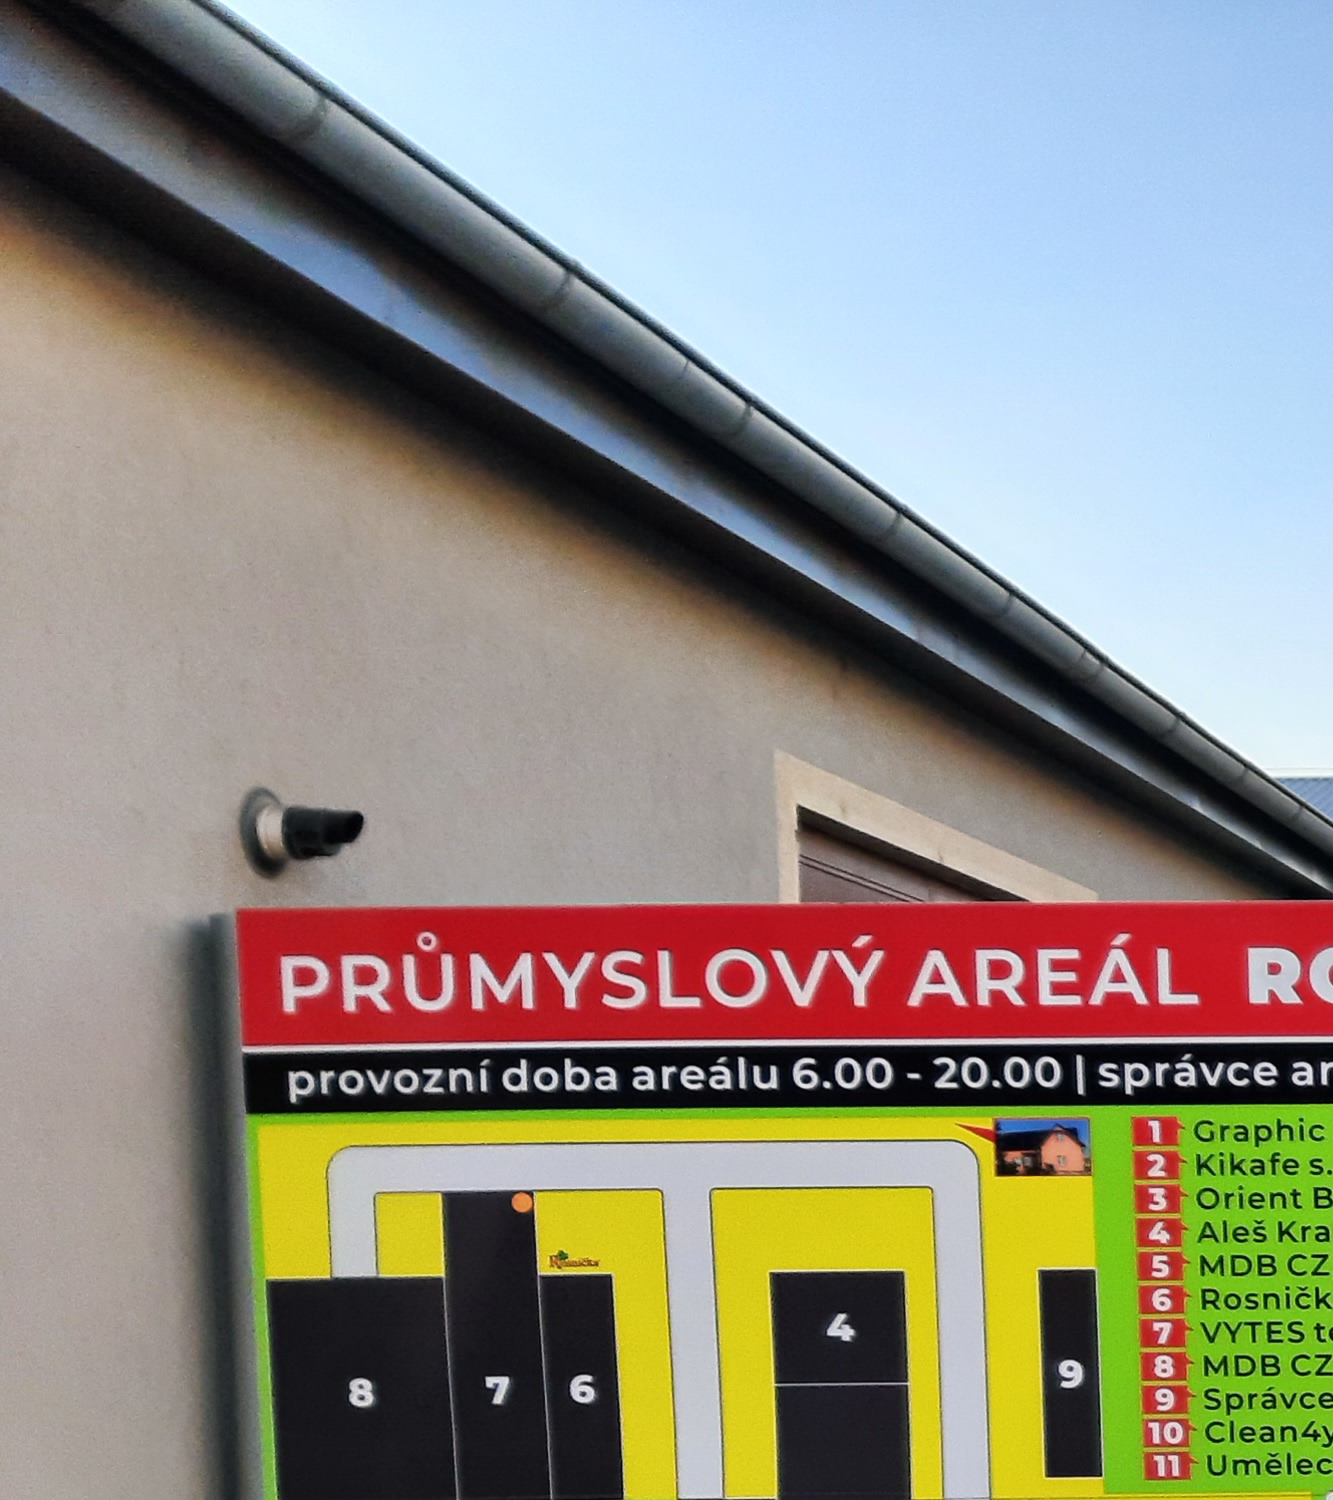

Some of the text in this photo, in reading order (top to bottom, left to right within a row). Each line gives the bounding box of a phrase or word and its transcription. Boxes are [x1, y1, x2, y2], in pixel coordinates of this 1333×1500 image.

[280, 931, 885, 1014] PRŮMYSLOVÝ
[907, 933, 1200, 1007] AREÁL
[288, 1058, 491, 1104] provozní
[501, 1057, 618, 1093] doba
[632, 1056, 779, 1091] areálu
[792, 1057, 894, 1090] 6.00
[932, 1055, 1062, 1089] 20.00
[1098, 1053, 1279, 1095] správce
[1147, 1120, 1161, 1143] 1
[1193, 1117, 1325, 1148] Graphic
[1146, 1153, 1167, 1177] 2
[1195, 1151, 1300, 1177] Kikafe
[1148, 1187, 1168, 1211] 3
[1196, 1185, 1303, 1211] Orient
[1148, 1221, 1171, 1244] 4
[1197, 1219, 1268, 1244] Aleš
[1151, 1254, 1170, 1278] 5
[1199, 1254, 1278, 1277] MDB
[1151, 1288, 1172, 1312] 6
[826, 1313, 856, 1342] 4
[1152, 1321, 1173, 1345] 7
[1200, 1320, 1306, 1344] VYTES
[1058, 1359, 1085, 1389] 9
[1153, 1355, 1174, 1378] 8
[1203, 1354, 1281, 1377] MDB
[348, 1377, 376, 1408] 8
[484, 1375, 511, 1405] 7
[569, 1374, 597, 1404] 6
[1155, 1388, 1175, 1412] 9
[1147, 1421, 1184, 1445] 10
[1153, 1454, 1180, 1477] 11
